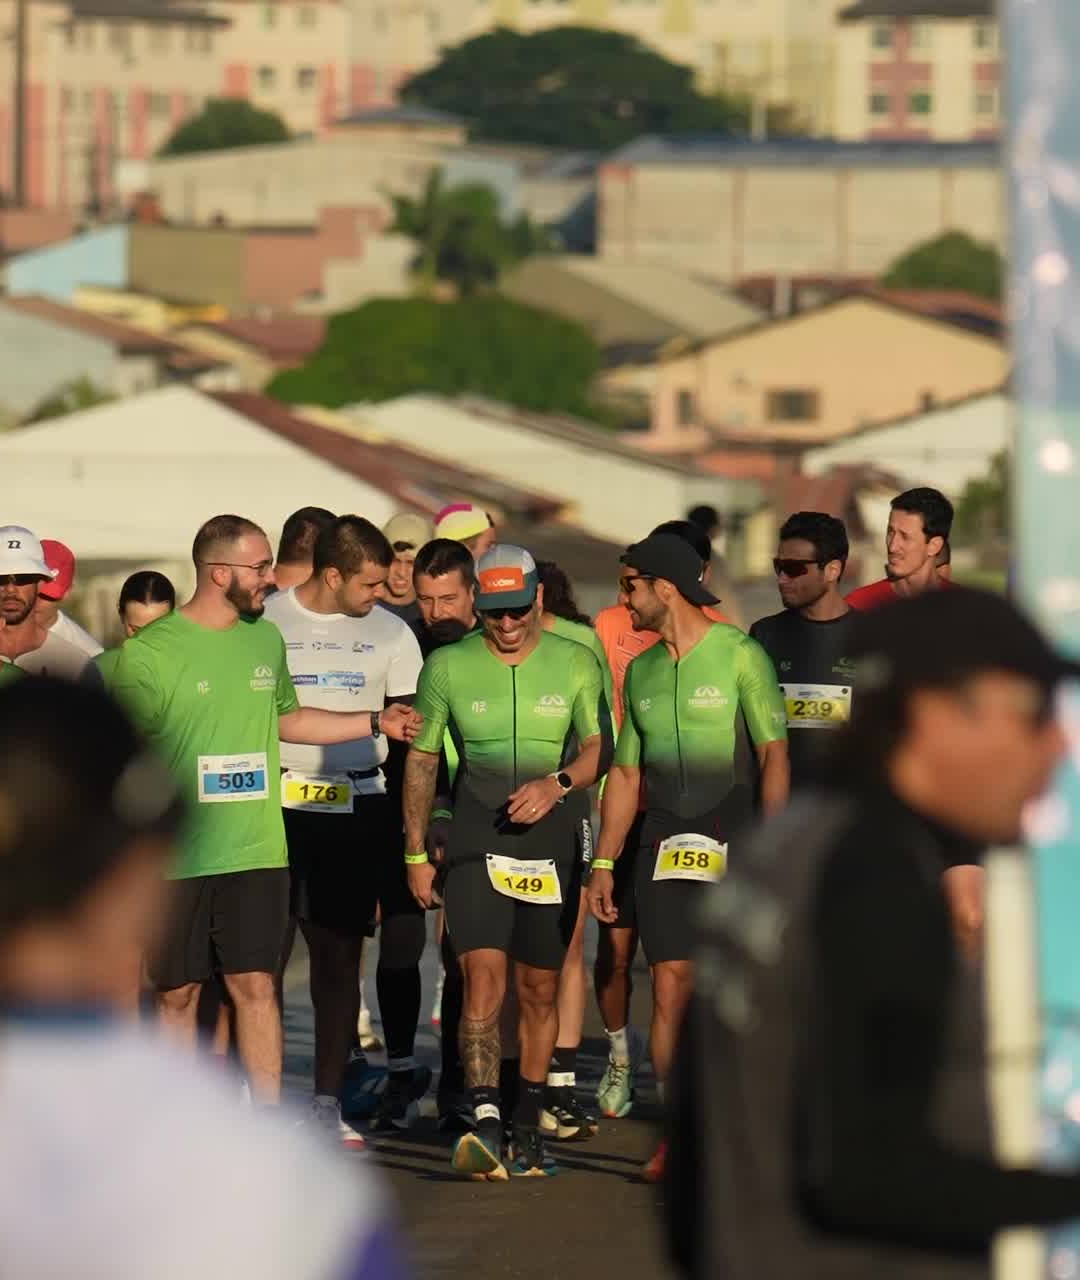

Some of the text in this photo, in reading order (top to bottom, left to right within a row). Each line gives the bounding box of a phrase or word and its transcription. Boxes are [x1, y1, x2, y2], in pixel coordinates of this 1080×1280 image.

[792, 700, 833, 717] 239
[218, 771, 256, 790] 503
[299, 784, 338, 801] 176
[671, 850, 710, 868] 158
[503, 875, 543, 893] 149
